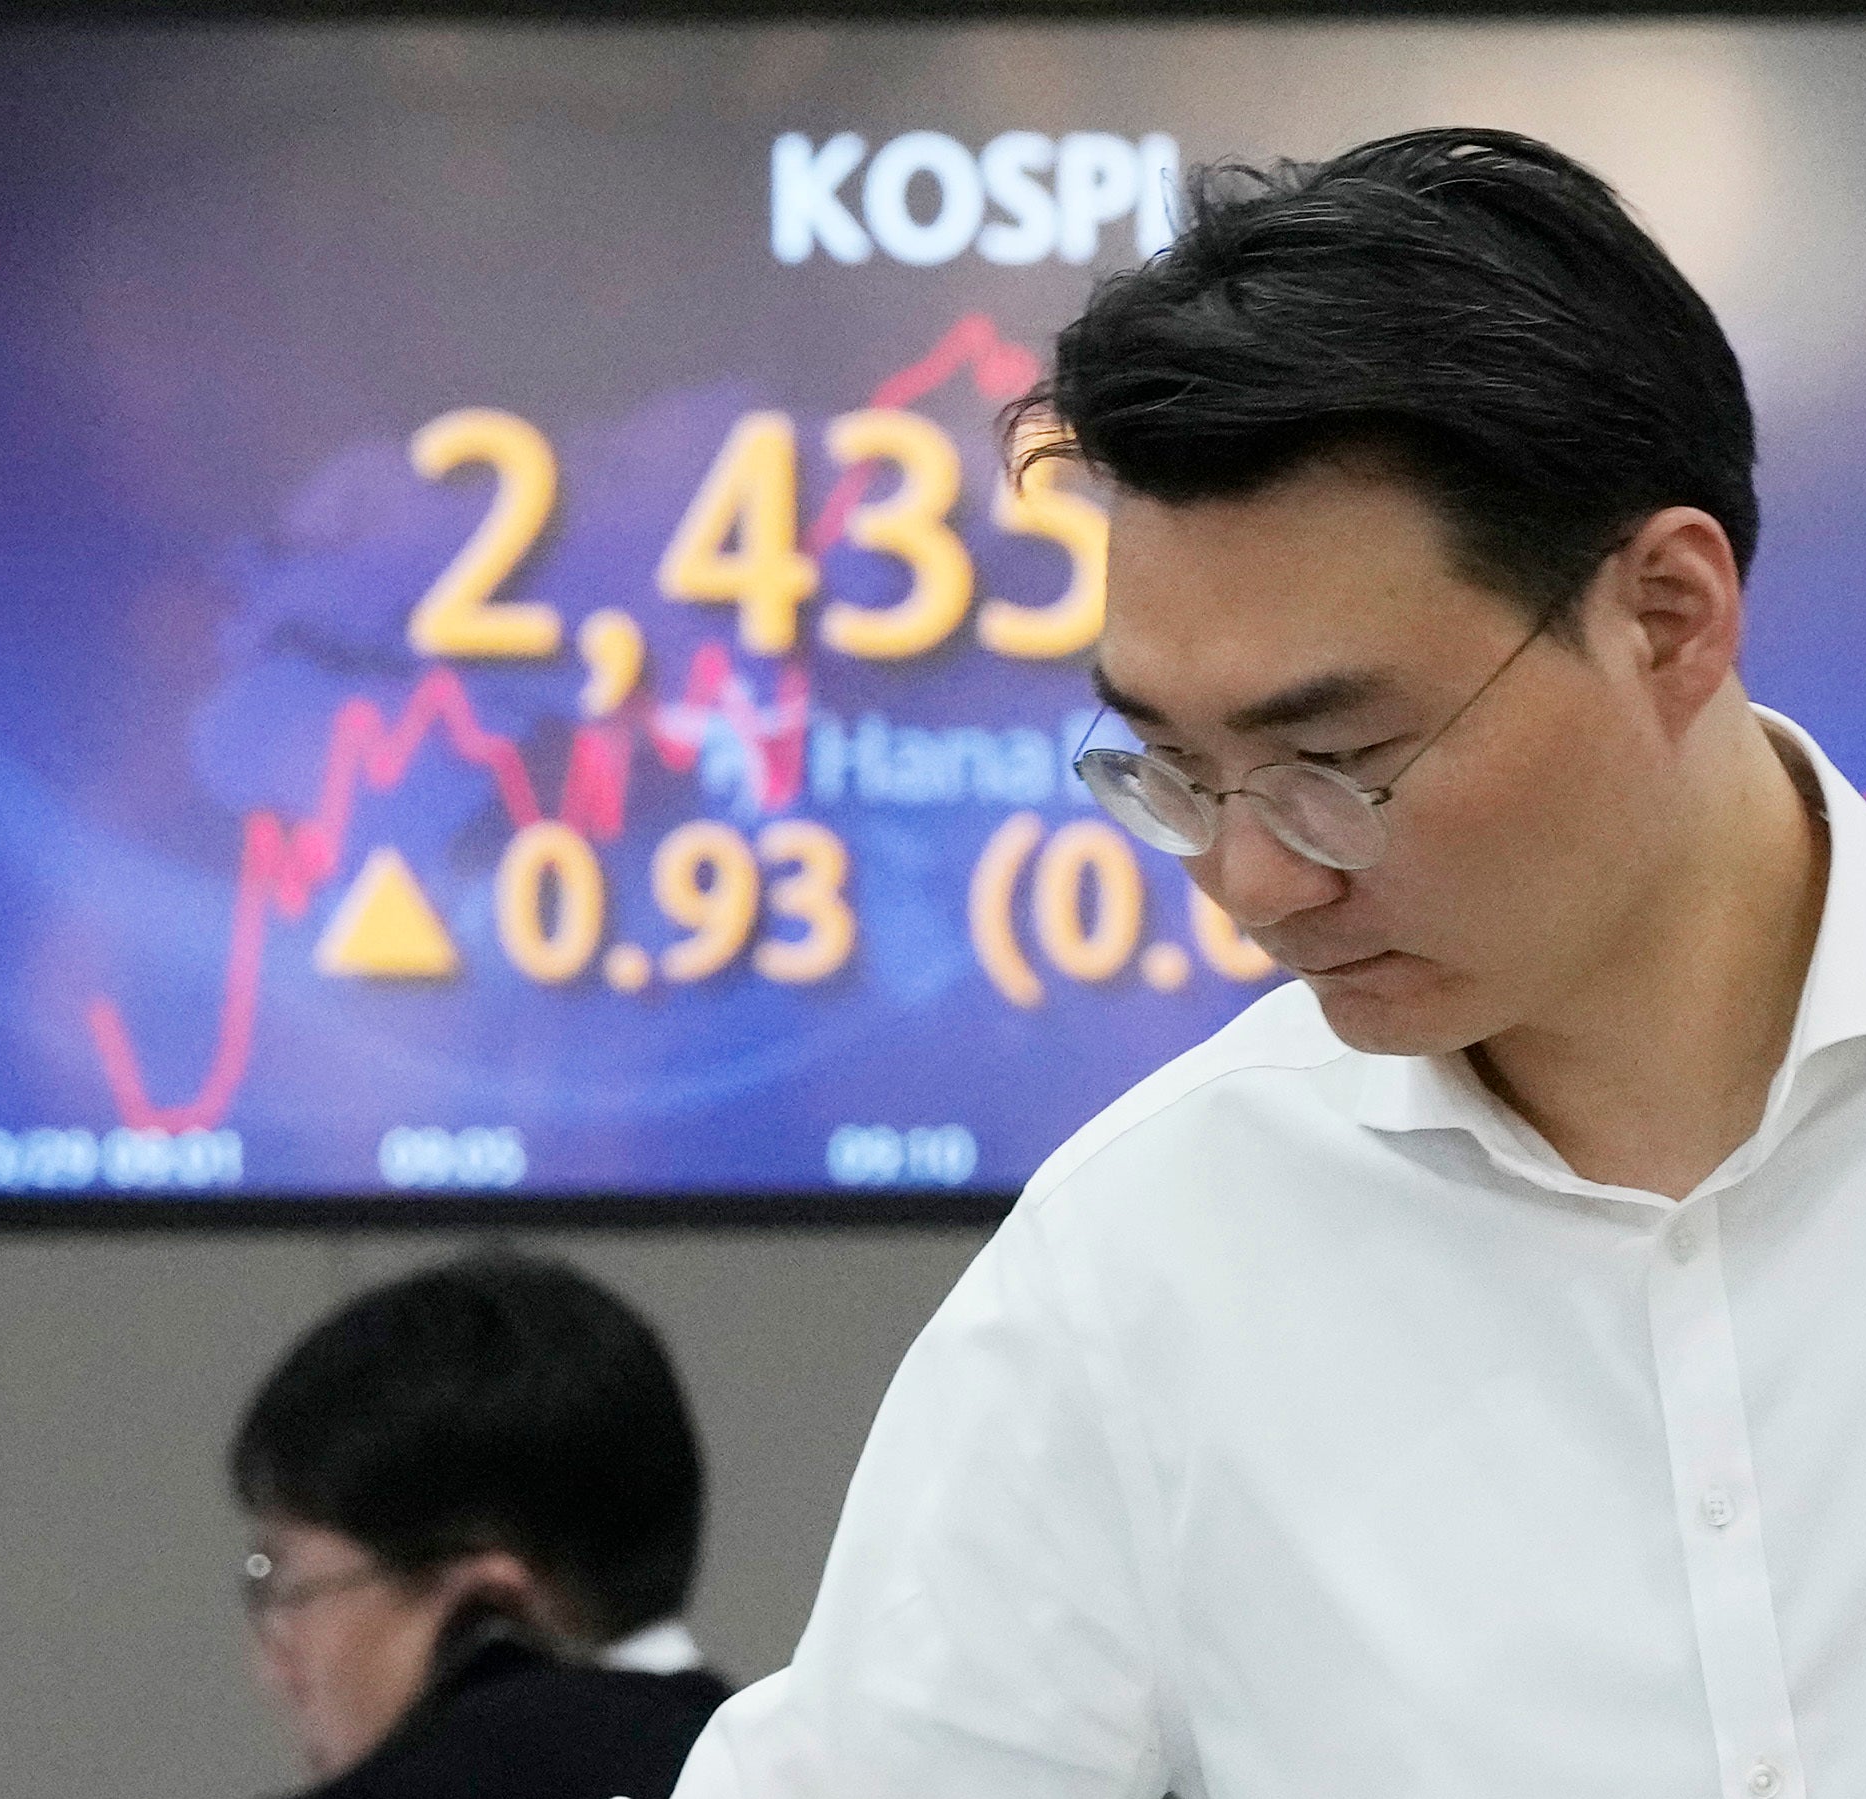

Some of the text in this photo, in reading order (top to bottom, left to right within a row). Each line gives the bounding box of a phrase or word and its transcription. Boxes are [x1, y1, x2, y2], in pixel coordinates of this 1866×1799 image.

[769, 129, 1182, 266] KOSPI
[807, 712, 1057, 805] Hana
[495, 820, 858, 992] 0.93
